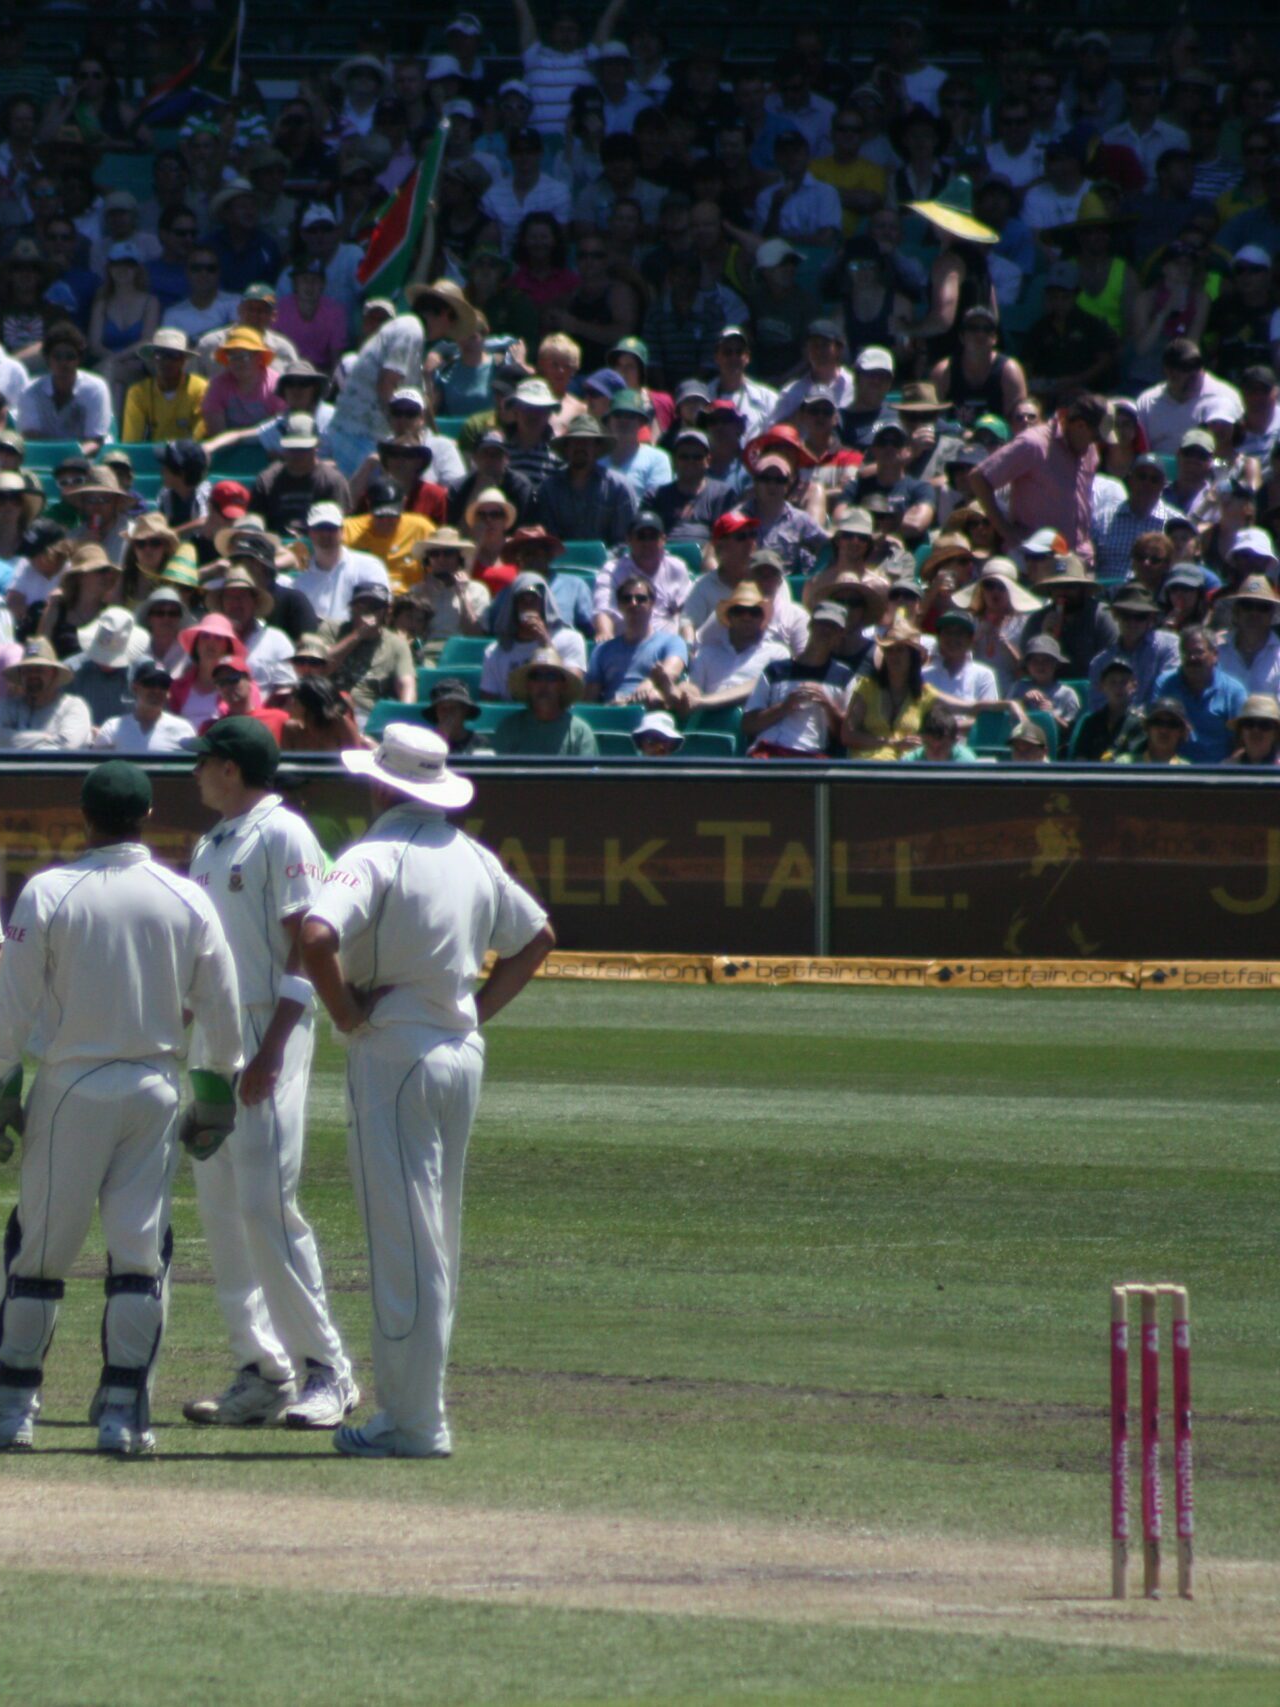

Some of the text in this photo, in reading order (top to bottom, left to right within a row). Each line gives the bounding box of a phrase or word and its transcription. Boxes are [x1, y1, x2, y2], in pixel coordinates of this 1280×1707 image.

[697, 821, 969, 910] TALL.
[544, 960, 710, 979] betfair.com
[756, 961, 924, 981] betfair.com
